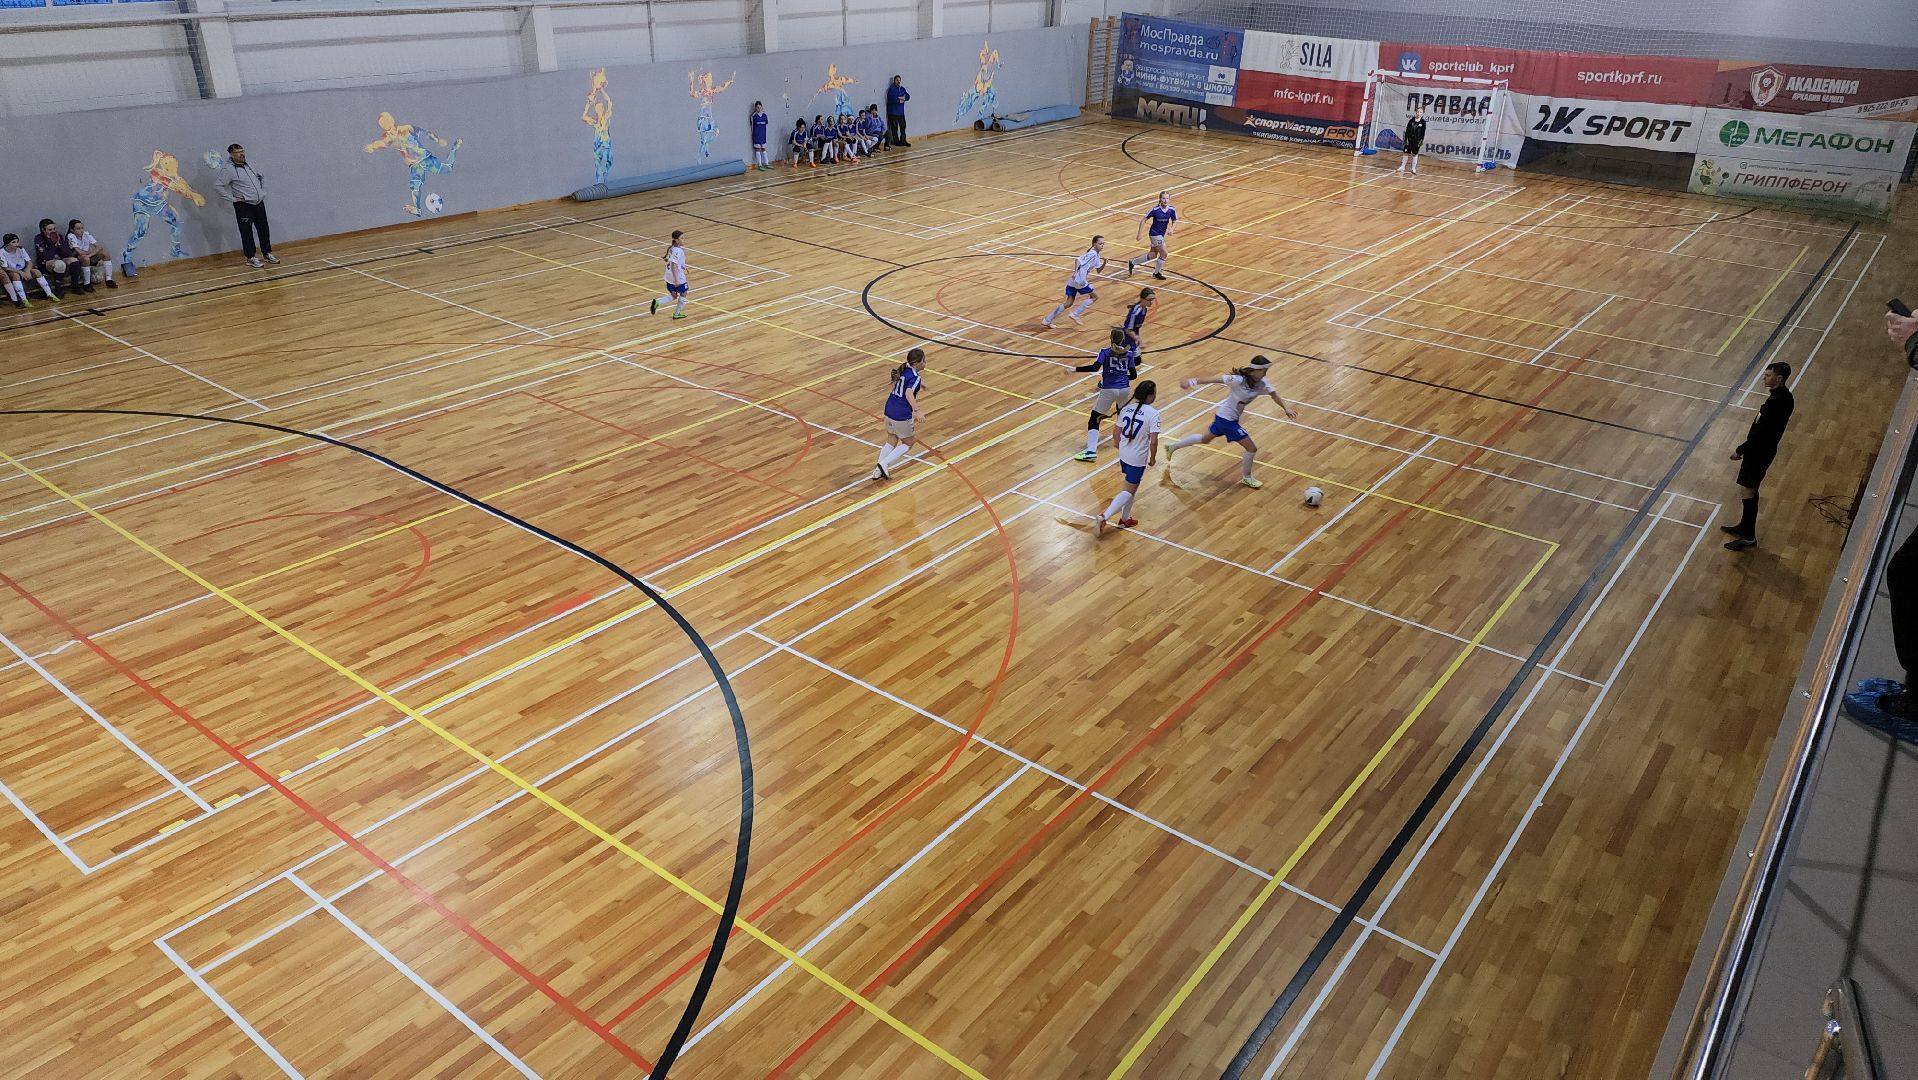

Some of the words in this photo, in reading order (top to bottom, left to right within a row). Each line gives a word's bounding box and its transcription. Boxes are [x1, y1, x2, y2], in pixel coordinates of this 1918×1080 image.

[1140, 24, 1204, 46] МосПравда
[1139, 41, 1219, 61] mospravda.ru
[1300, 42, 1332, 68] SILA
[1428, 60, 1515, 76] sportclub_kprf
[1577, 70, 1663, 85] sportkprf.ru
[1203, 82, 1234, 94] ШКОЛУ
[1785, 76, 1860, 95] АКАДЕМИЯ
[1273, 88, 1334, 105] mfc-kprf.ru
[1406, 92, 1491, 118] ПРАВДА
[1327, 128, 1355, 139] PRO
[1532, 104, 1585, 135] 2K
[1582, 115, 1692, 143] SPORT
[1754, 127, 1895, 154] МЕГАФОН
[1733, 172, 1848, 193] ГРИППФЕРОН
[1122, 416, 1144, 440] 27
